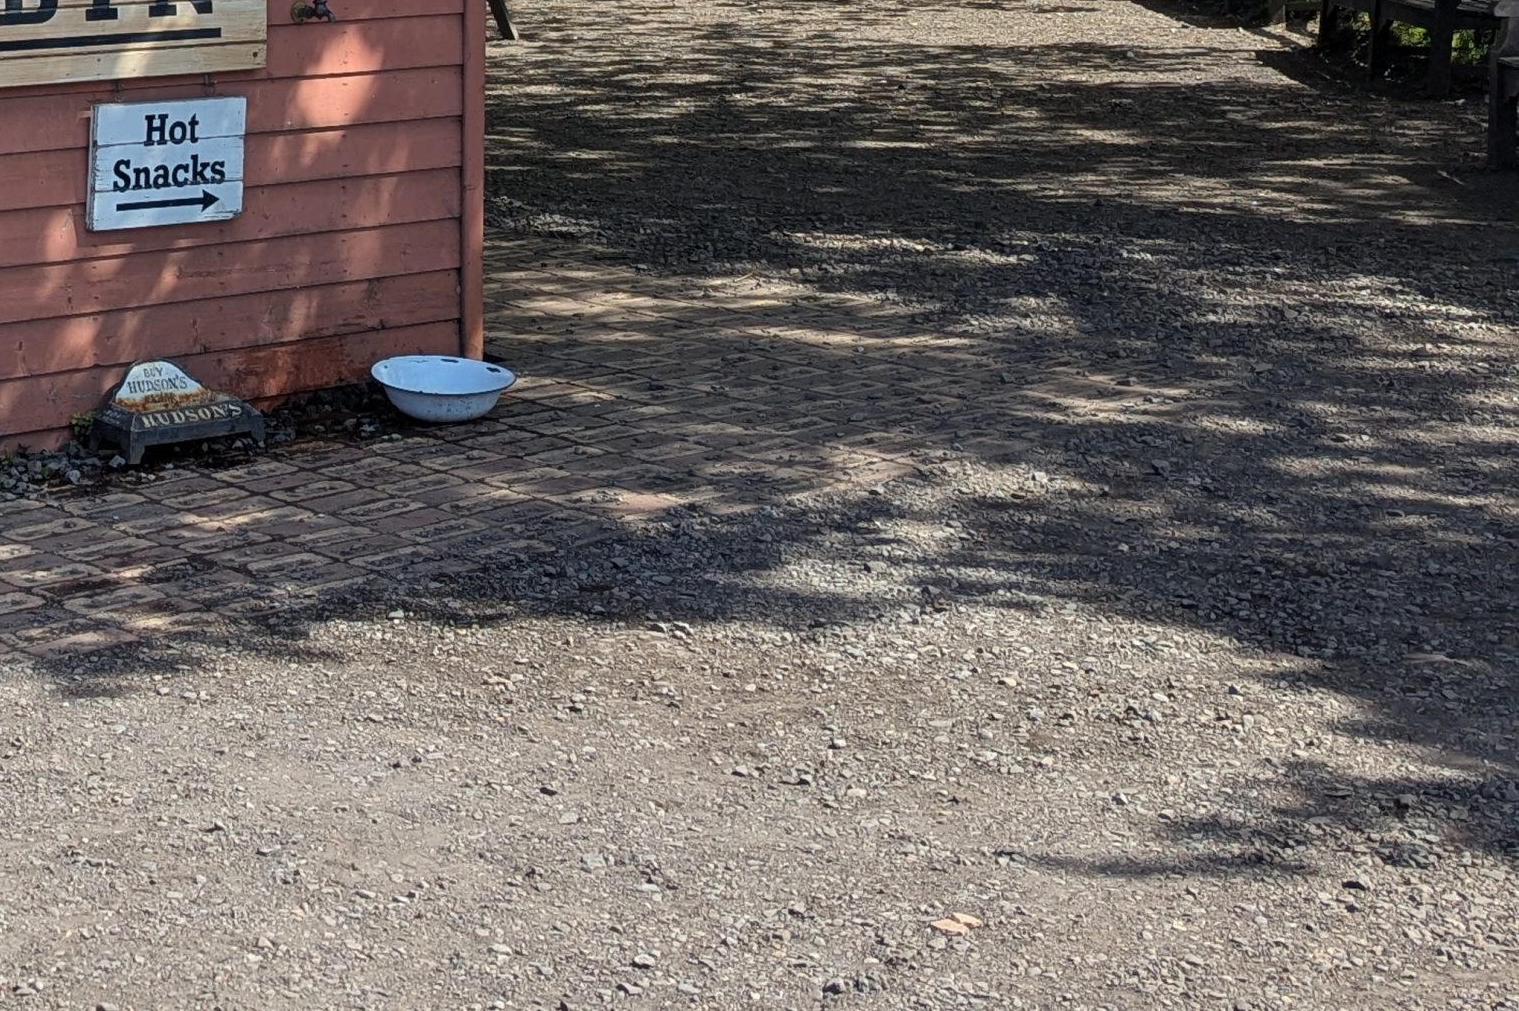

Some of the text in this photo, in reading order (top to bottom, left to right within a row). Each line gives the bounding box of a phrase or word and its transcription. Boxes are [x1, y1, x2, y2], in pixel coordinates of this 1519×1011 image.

[143, 113, 200, 147] Hot
[113, 153, 226, 193] Snacks
[127, 374, 188, 394] HUDSON'S
[143, 367, 163, 378] BUY
[142, 403, 243, 429] HUDSON'S
